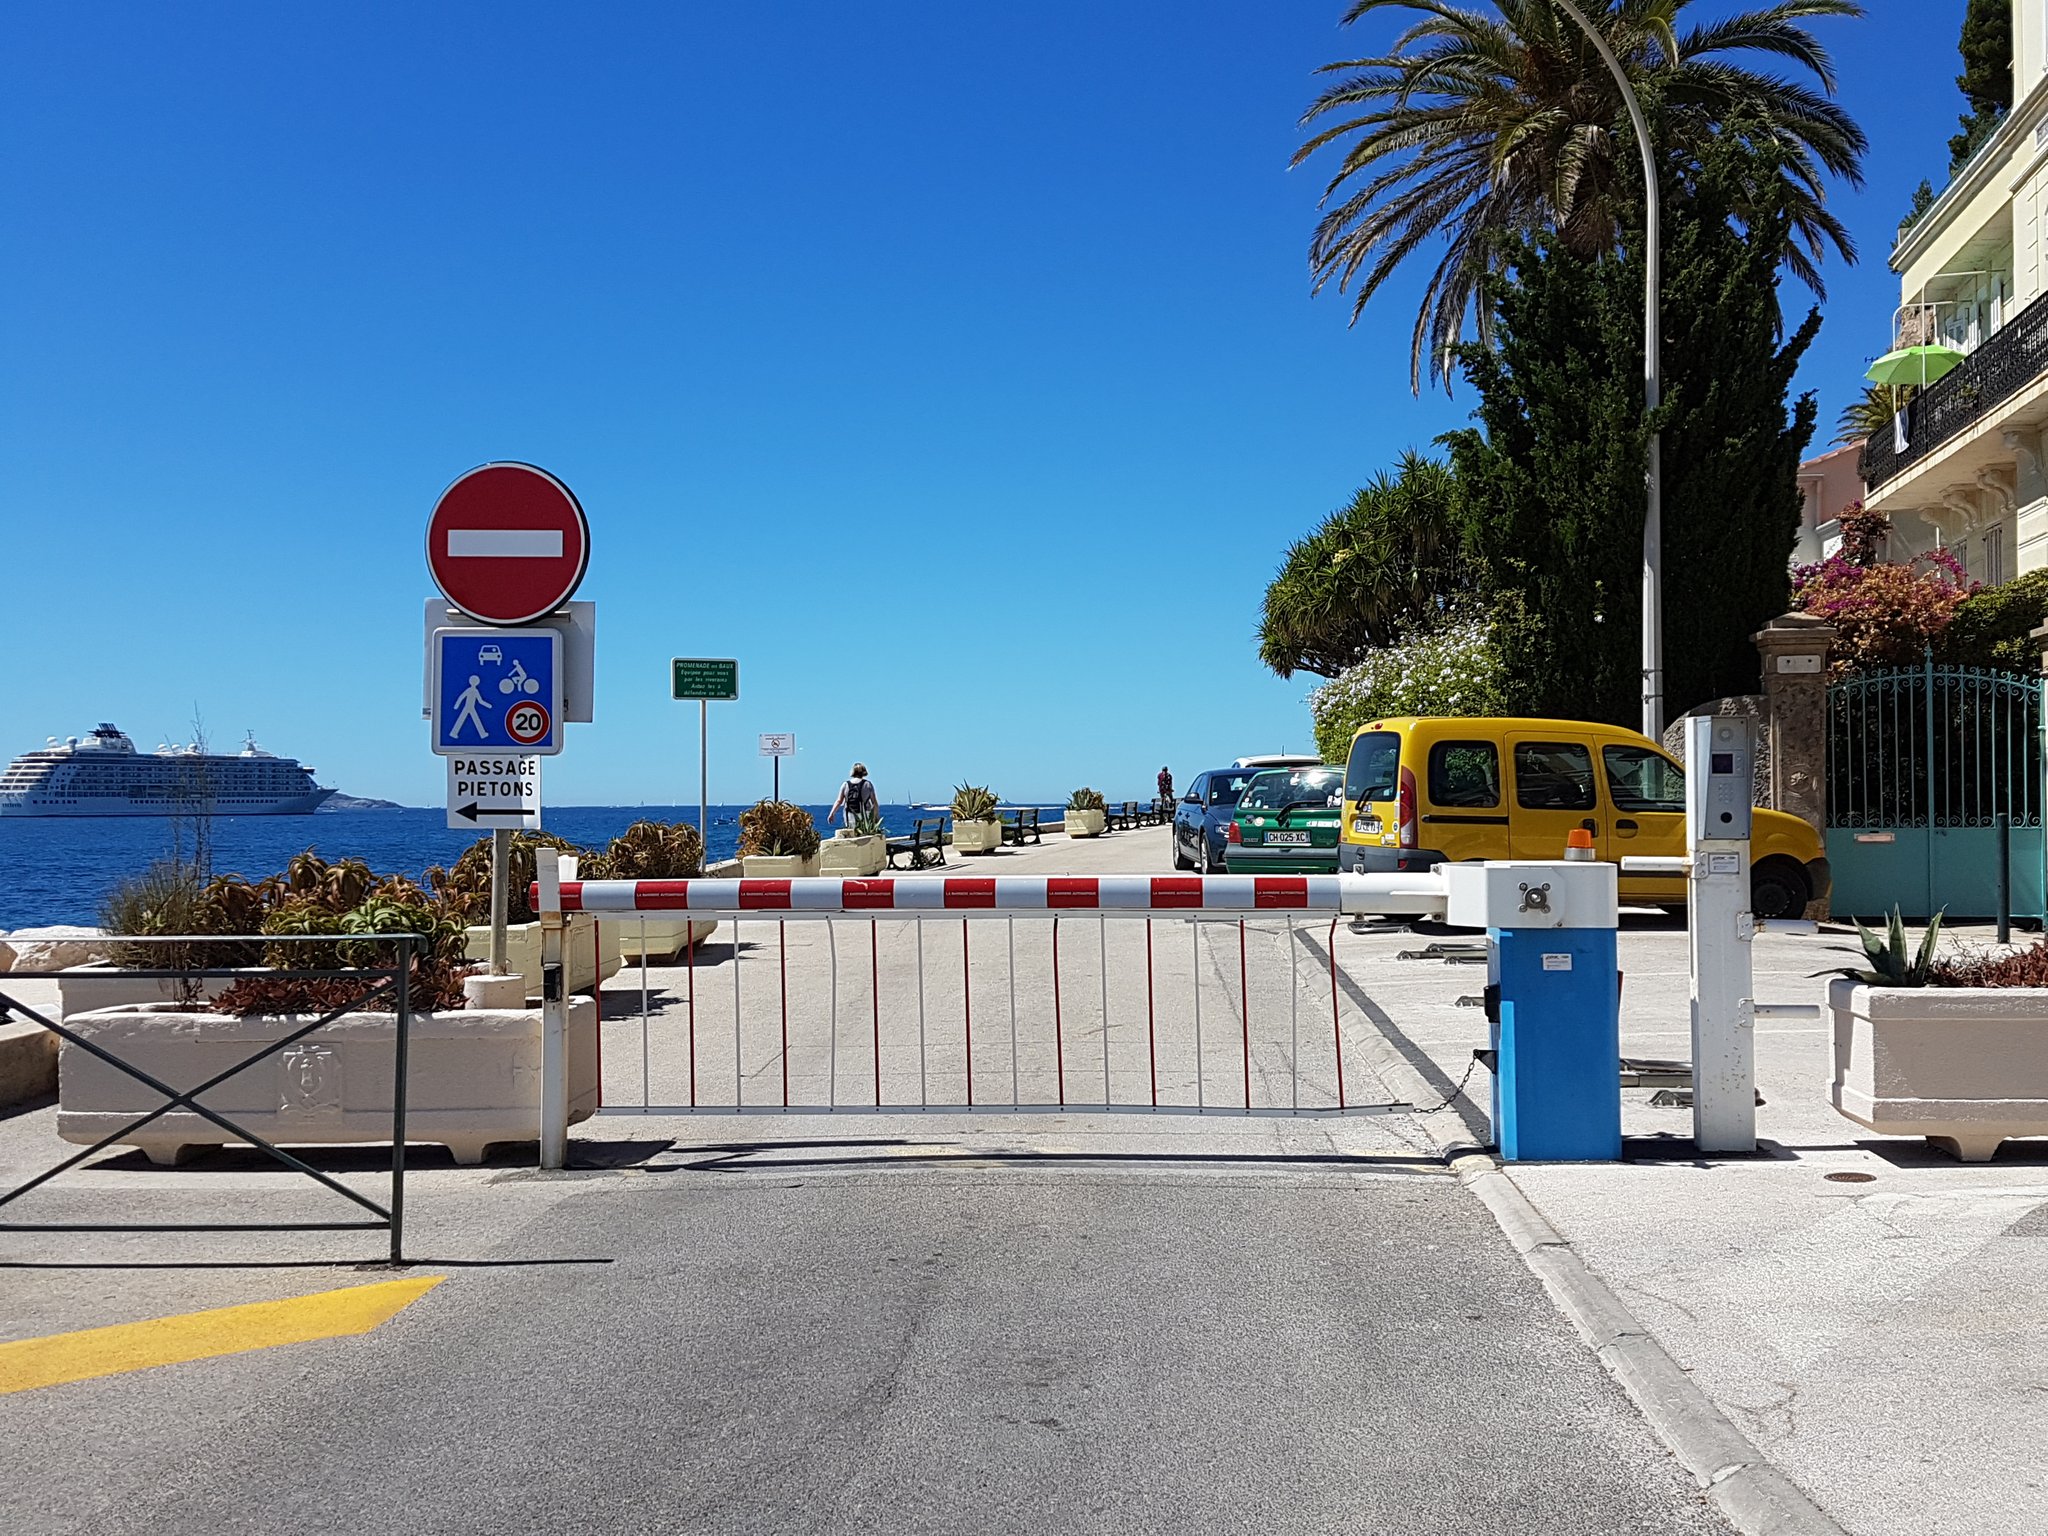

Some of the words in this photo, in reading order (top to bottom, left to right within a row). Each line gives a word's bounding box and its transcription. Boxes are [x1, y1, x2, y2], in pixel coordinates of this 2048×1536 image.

[515, 713, 542, 731] 20
[454, 760, 536, 775] PASSAGE
[457, 781, 533, 797] PIETONS
[1268, 832, 1279, 842] CH
